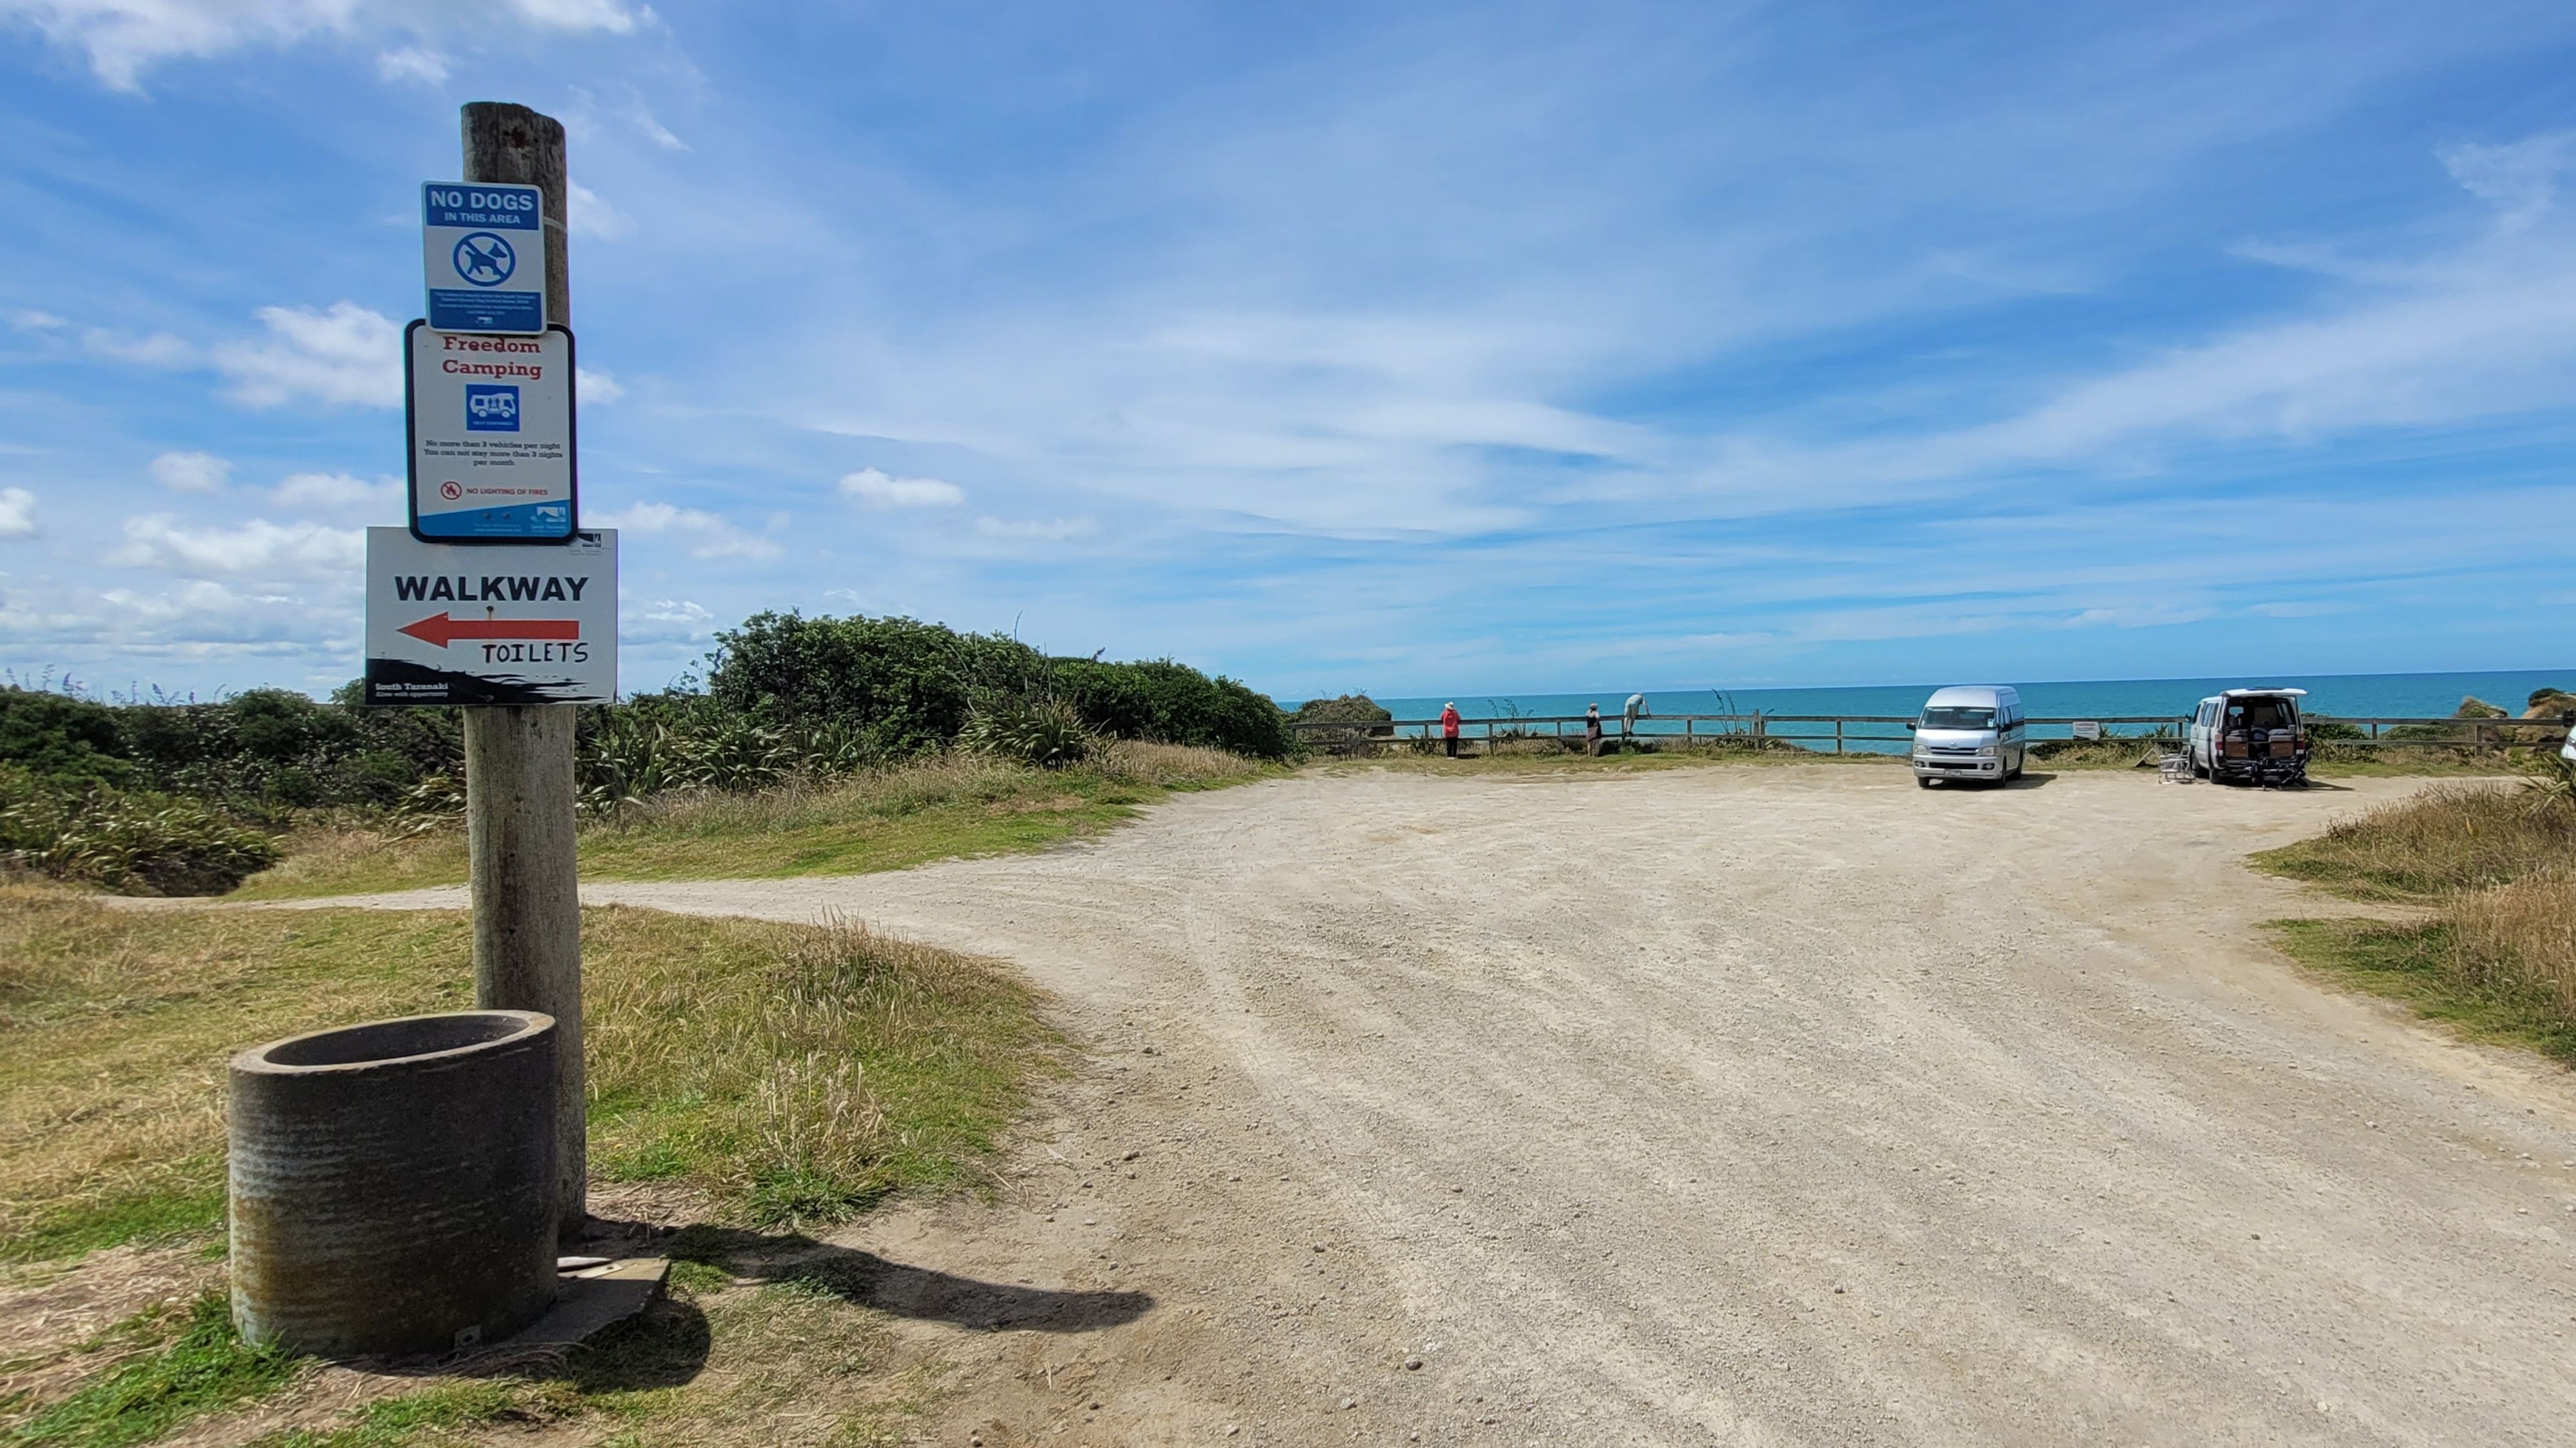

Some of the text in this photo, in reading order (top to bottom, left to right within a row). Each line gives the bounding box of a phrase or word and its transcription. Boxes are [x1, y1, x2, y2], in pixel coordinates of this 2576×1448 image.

[431, 190, 533, 211] NO DOGS
[444, 213, 520, 224] IN THIS AREA
[443, 336, 541, 354] Freedom
[442, 359, 543, 380] Camping
[394, 576, 590, 602] WALKWAY
[482, 642, 589, 663] TOILETS
